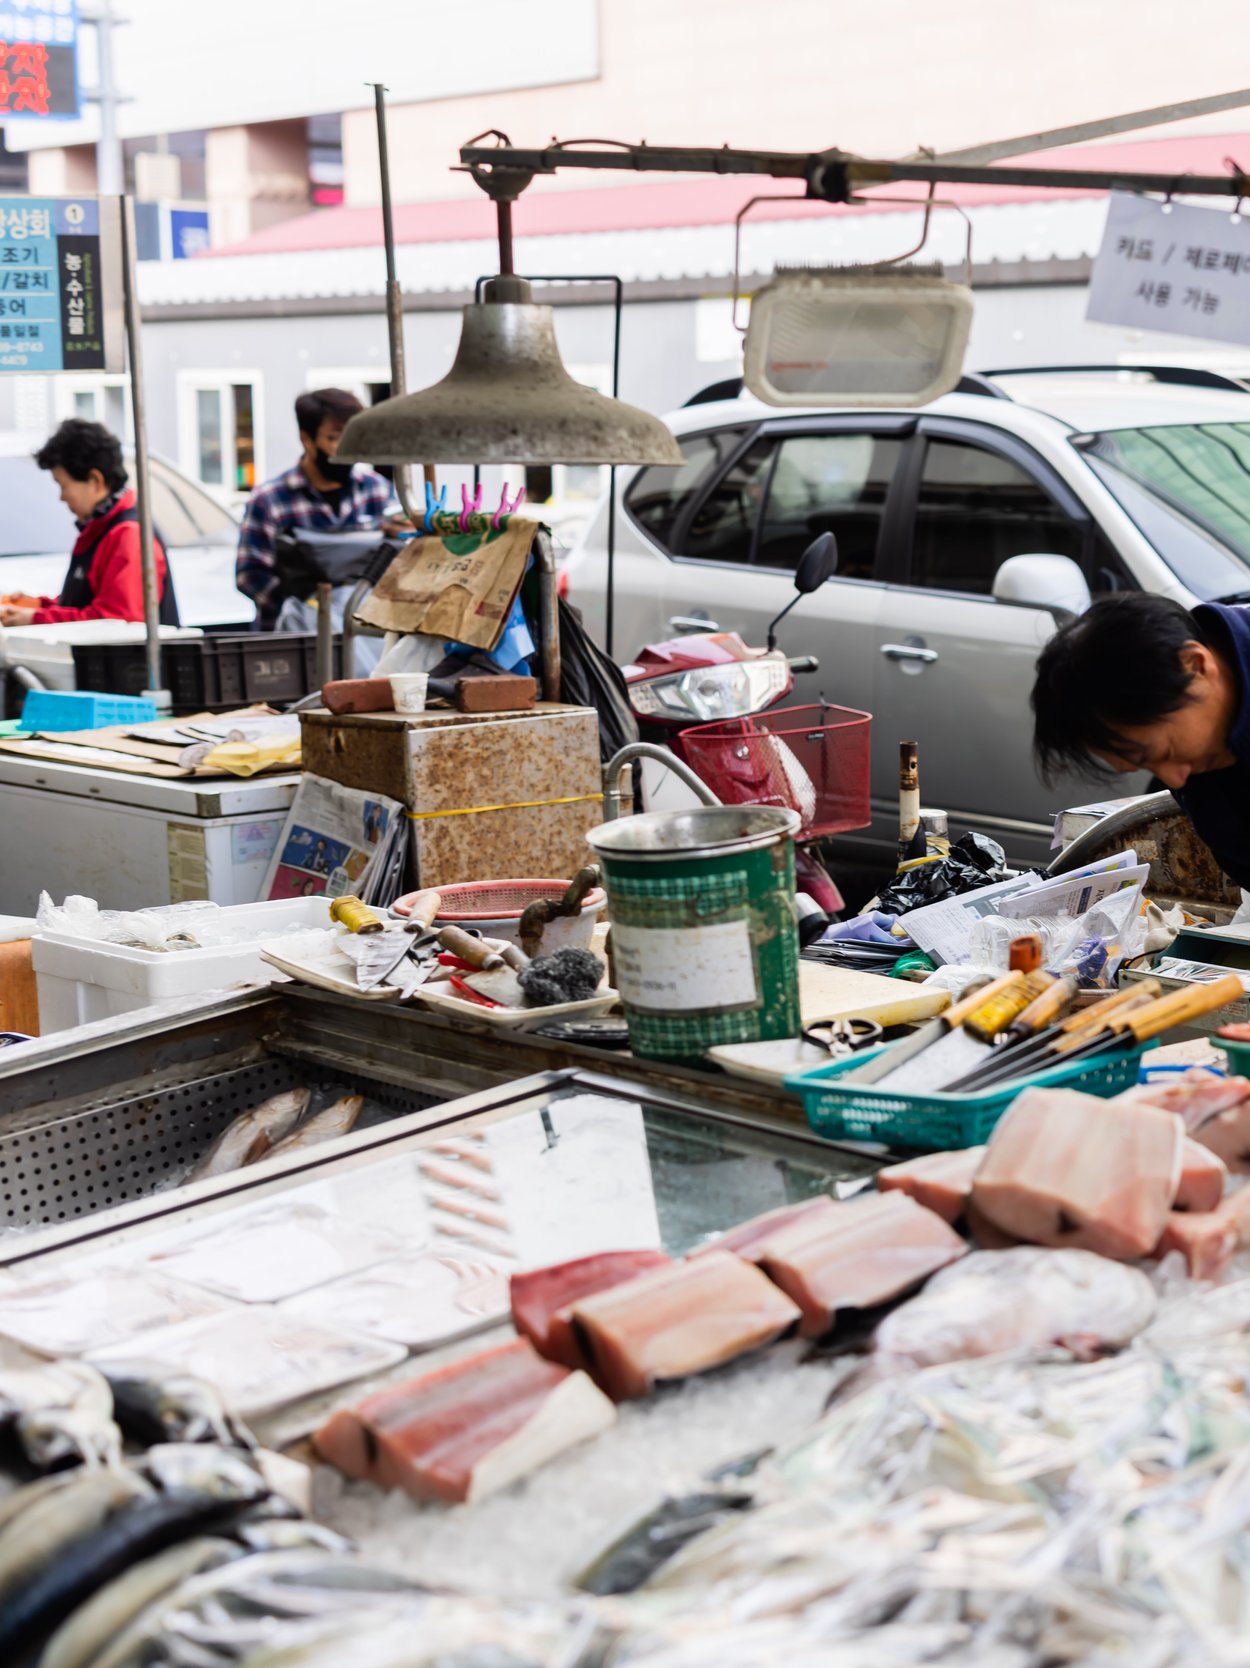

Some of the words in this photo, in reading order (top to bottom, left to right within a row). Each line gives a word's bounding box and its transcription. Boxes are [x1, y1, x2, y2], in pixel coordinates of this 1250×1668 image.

[2, 247, 39, 264] 조기
[1115, 235, 1155, 262] 카드
[1135, 280, 1173, 307] 사용
[1182, 286, 1221, 315] 가능
